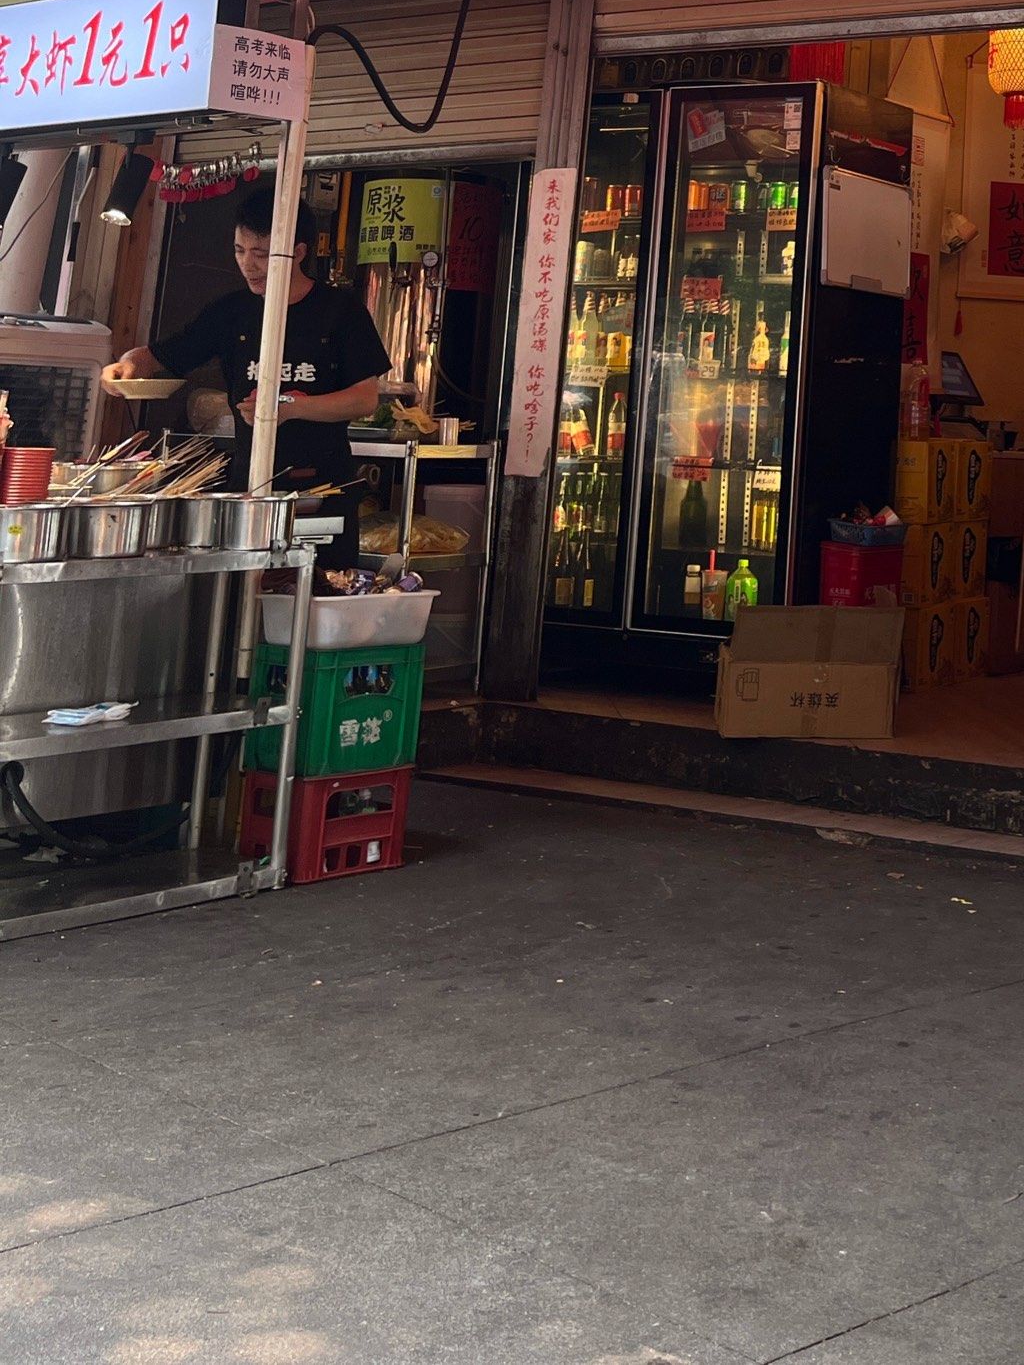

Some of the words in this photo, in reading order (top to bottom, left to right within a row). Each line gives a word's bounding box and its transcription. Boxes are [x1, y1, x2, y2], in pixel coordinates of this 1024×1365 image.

[234, 35, 291, 61] 高考来临
[232, 59, 290, 83] 请勿大声
[367, 186, 406, 223] 原浆
[542, 179, 562, 244] 来我们家
